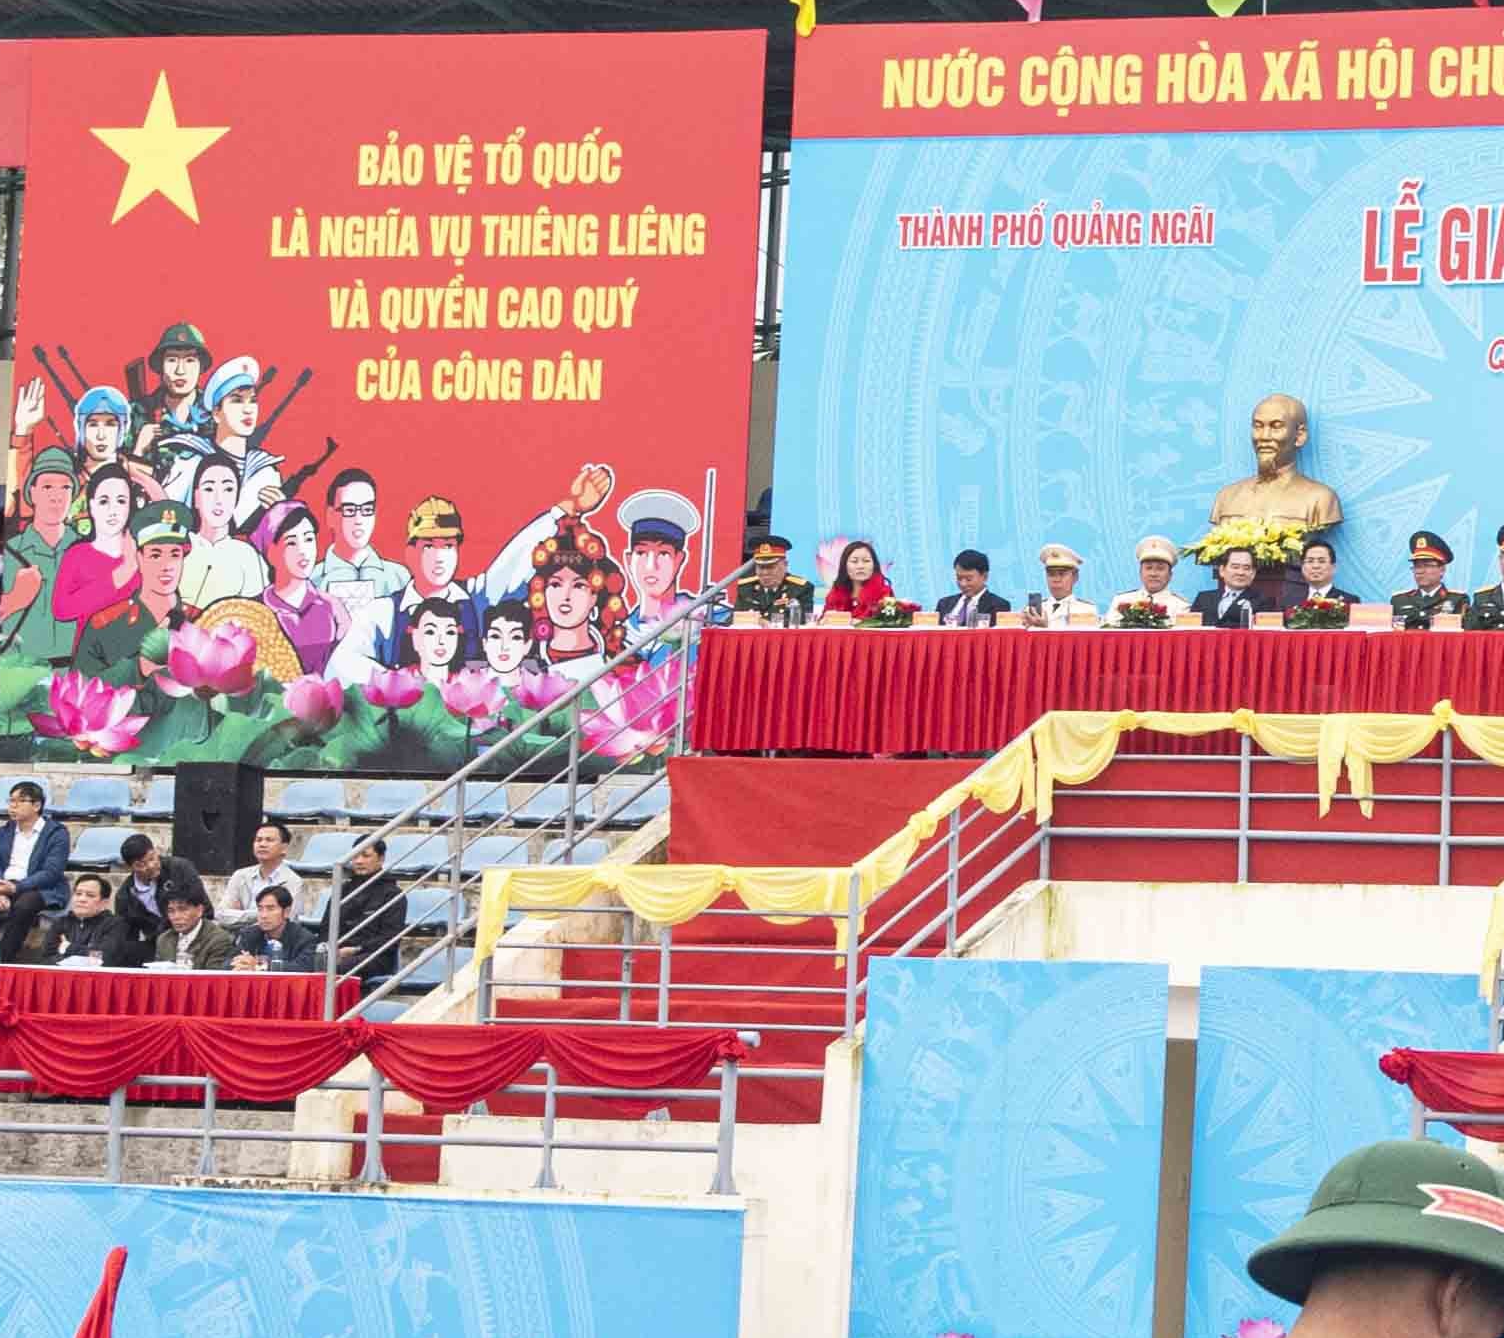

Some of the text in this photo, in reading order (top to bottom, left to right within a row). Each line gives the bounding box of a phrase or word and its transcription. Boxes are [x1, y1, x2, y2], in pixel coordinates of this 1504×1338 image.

[882, 48, 1004, 109] NƯỚC
[1019, 46, 1142, 117] CỘNG
[1155, 40, 1247, 104] HÒA
[1262, 40, 1322, 101] XÃ
[1336, 38, 1414, 110] HỘI
[357, 126, 622, 194] BẢO VỆ TỔ QUỐC
[270, 204, 706, 266] LÀ NGHĨA VỤ THIÊNG LIÊNG
[898, 201, 1215, 249] THÀNH PHỐ QUẢNG NGÃI
[1362, 180, 1423, 283] LỄ
[328, 273, 640, 333] VÀ QUYỀN CAO QUÝ
[355, 345, 603, 402] CỦA CÔNG DÂN
